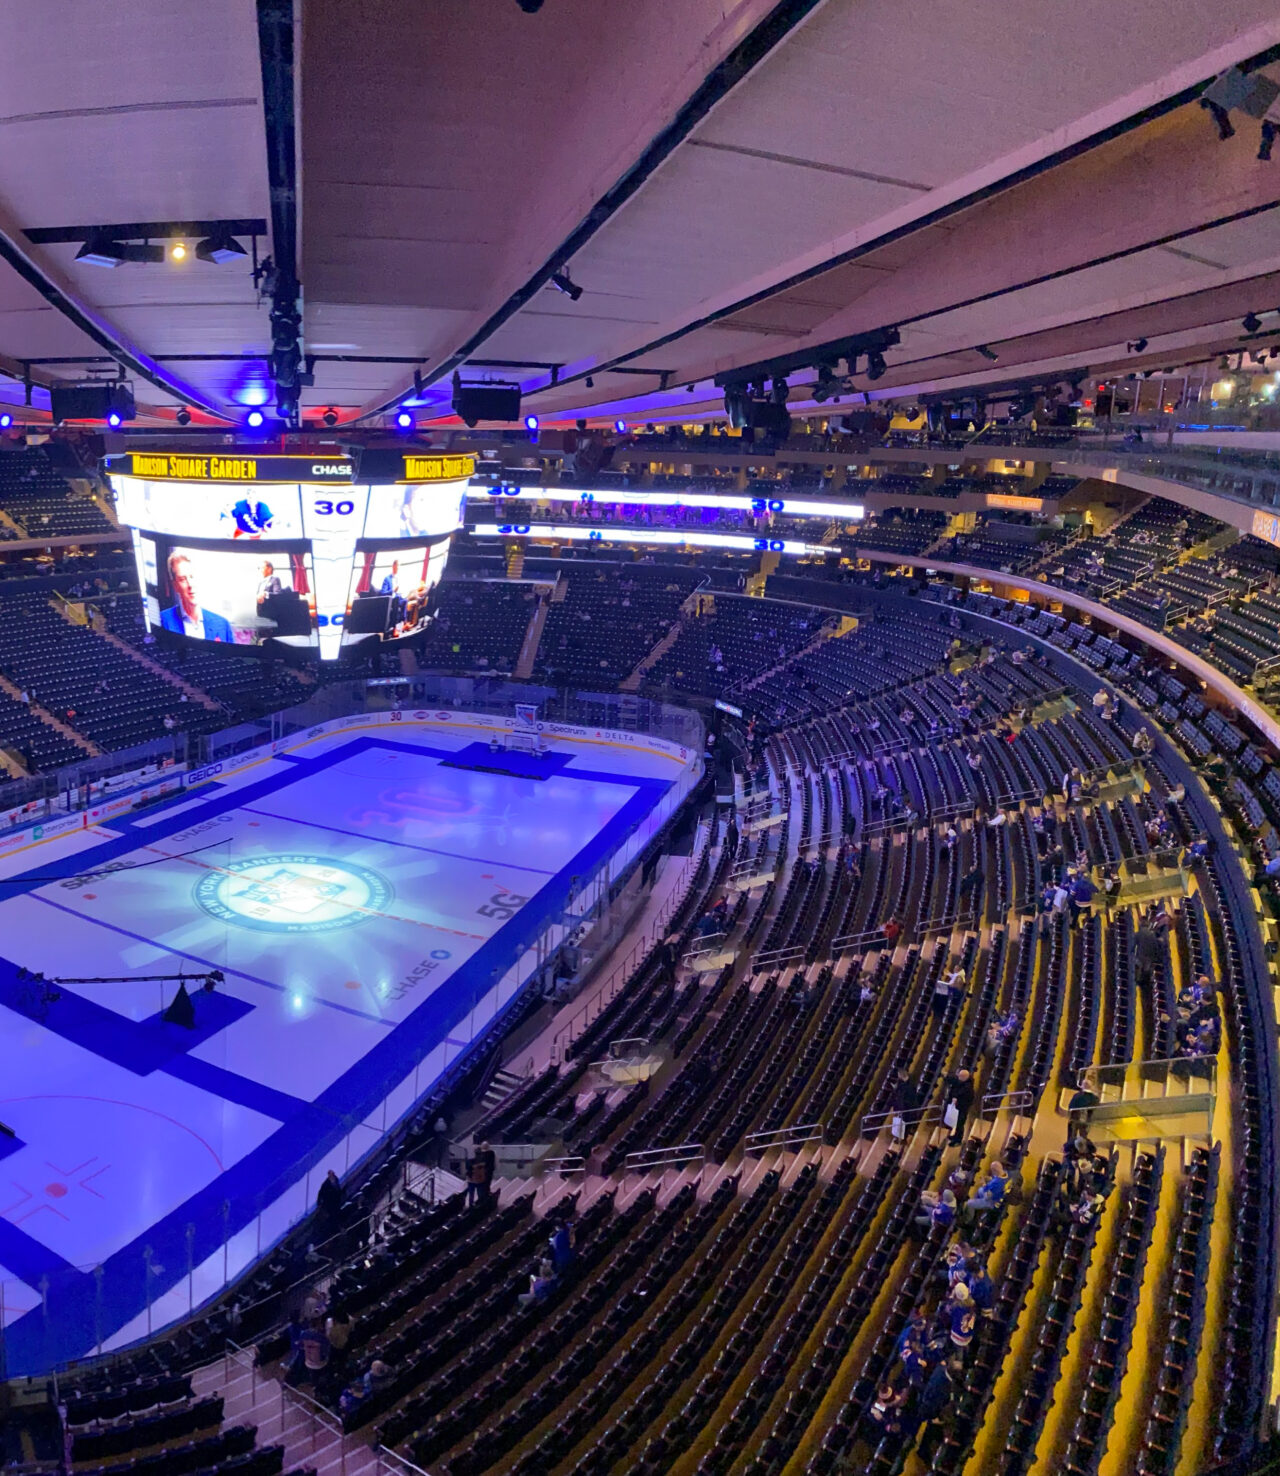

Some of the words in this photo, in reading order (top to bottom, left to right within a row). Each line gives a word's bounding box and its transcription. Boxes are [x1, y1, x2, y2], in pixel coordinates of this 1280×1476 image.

[132, 455, 168, 475] MADISON
[170, 456, 208, 477] SQUARE
[210, 457, 257, 479] GARDEN
[312, 465, 352, 475] CHASE
[406, 458, 441, 479] MADISON
[442, 457, 463, 478] SQUARE
[314, 500, 355, 515] 30
[752, 498, 784, 512] 30
[754, 539, 785, 552] 30
[391, 712, 402, 721] 30
[549, 724, 587, 736] Spectrum
[605, 732, 634, 742] DELTA
[188, 763, 223, 784] GEICO
[172, 821, 217, 843] CHASE
[228, 856, 319, 872] RANGERS
[199, 873, 225, 897] YORK
[202, 899, 237, 919] NEW
[475, 893, 531, 921] 5G
[287, 919, 352, 932] MADISON
[385, 959, 440, 1001] CHASE
